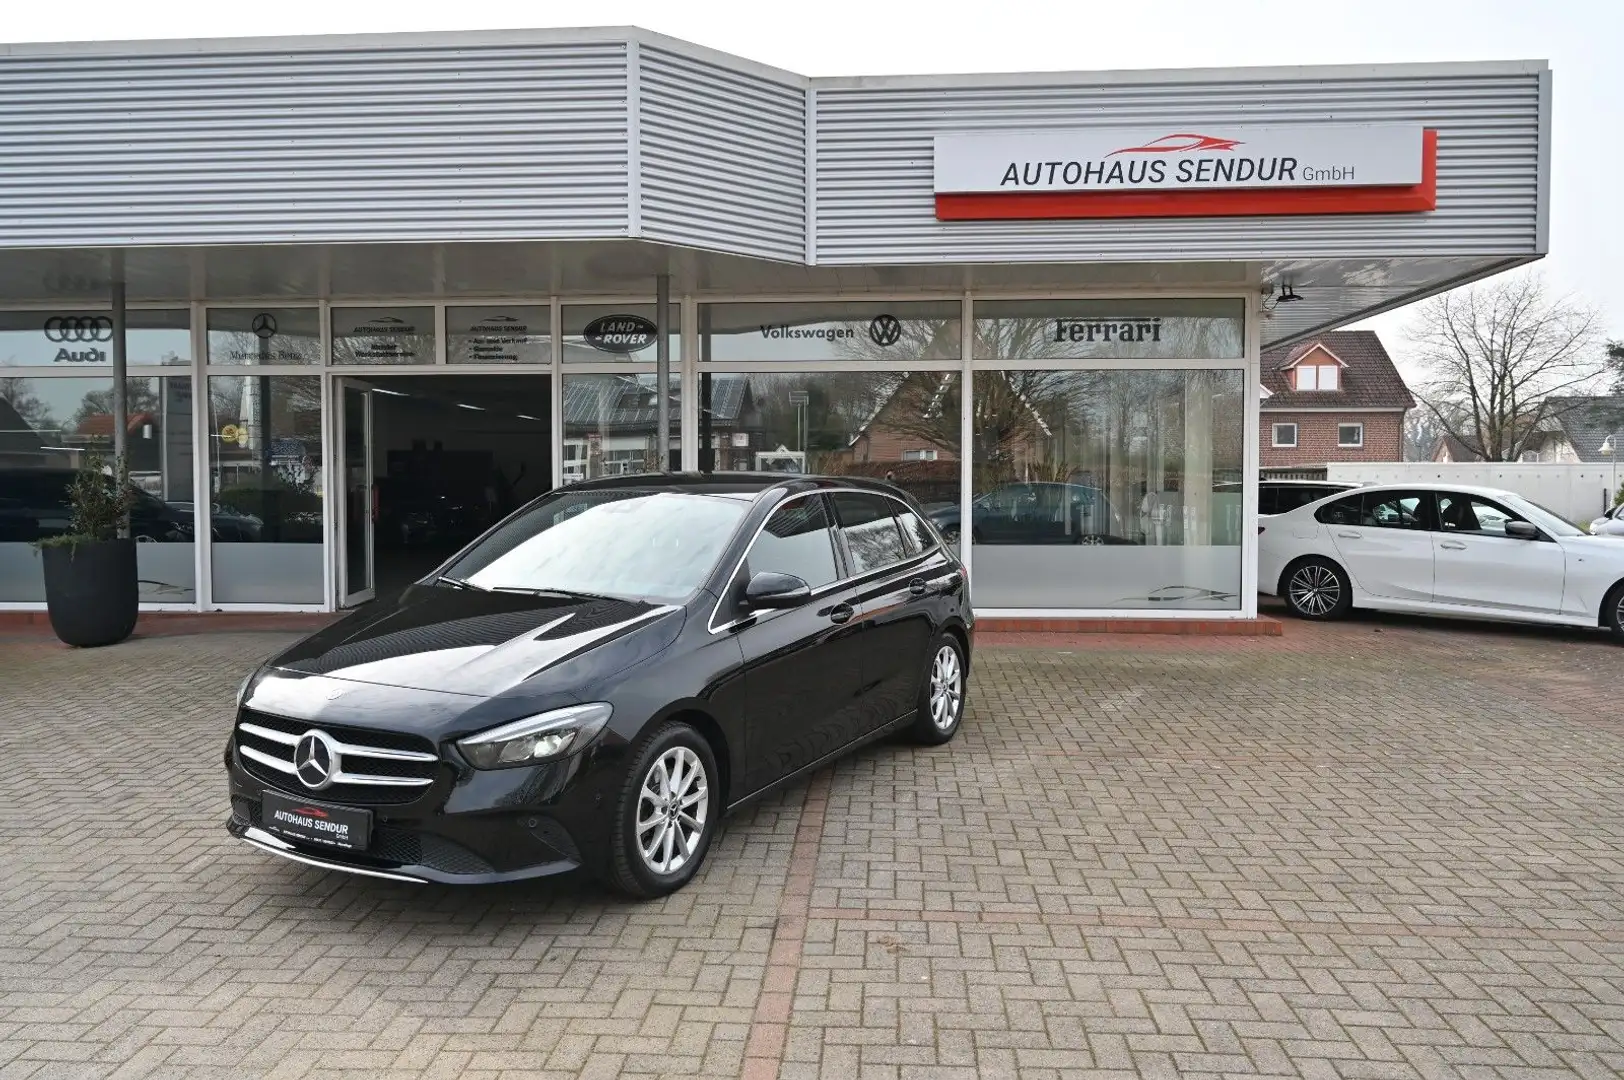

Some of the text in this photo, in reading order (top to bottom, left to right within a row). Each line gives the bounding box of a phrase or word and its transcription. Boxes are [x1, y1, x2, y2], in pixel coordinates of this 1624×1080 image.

[1000, 157, 1355, 186] AUTOHAUS SENDUR GmbH
[600, 321, 636, 332] LAND
[760, 325, 854, 342] Volkswagen
[1053, 317, 1161, 342] Ferrari
[603, 333, 648, 345] ROVER
[53, 347, 106, 362] Audi
[274, 810, 349, 834] AUTOHAUS SENDUR
